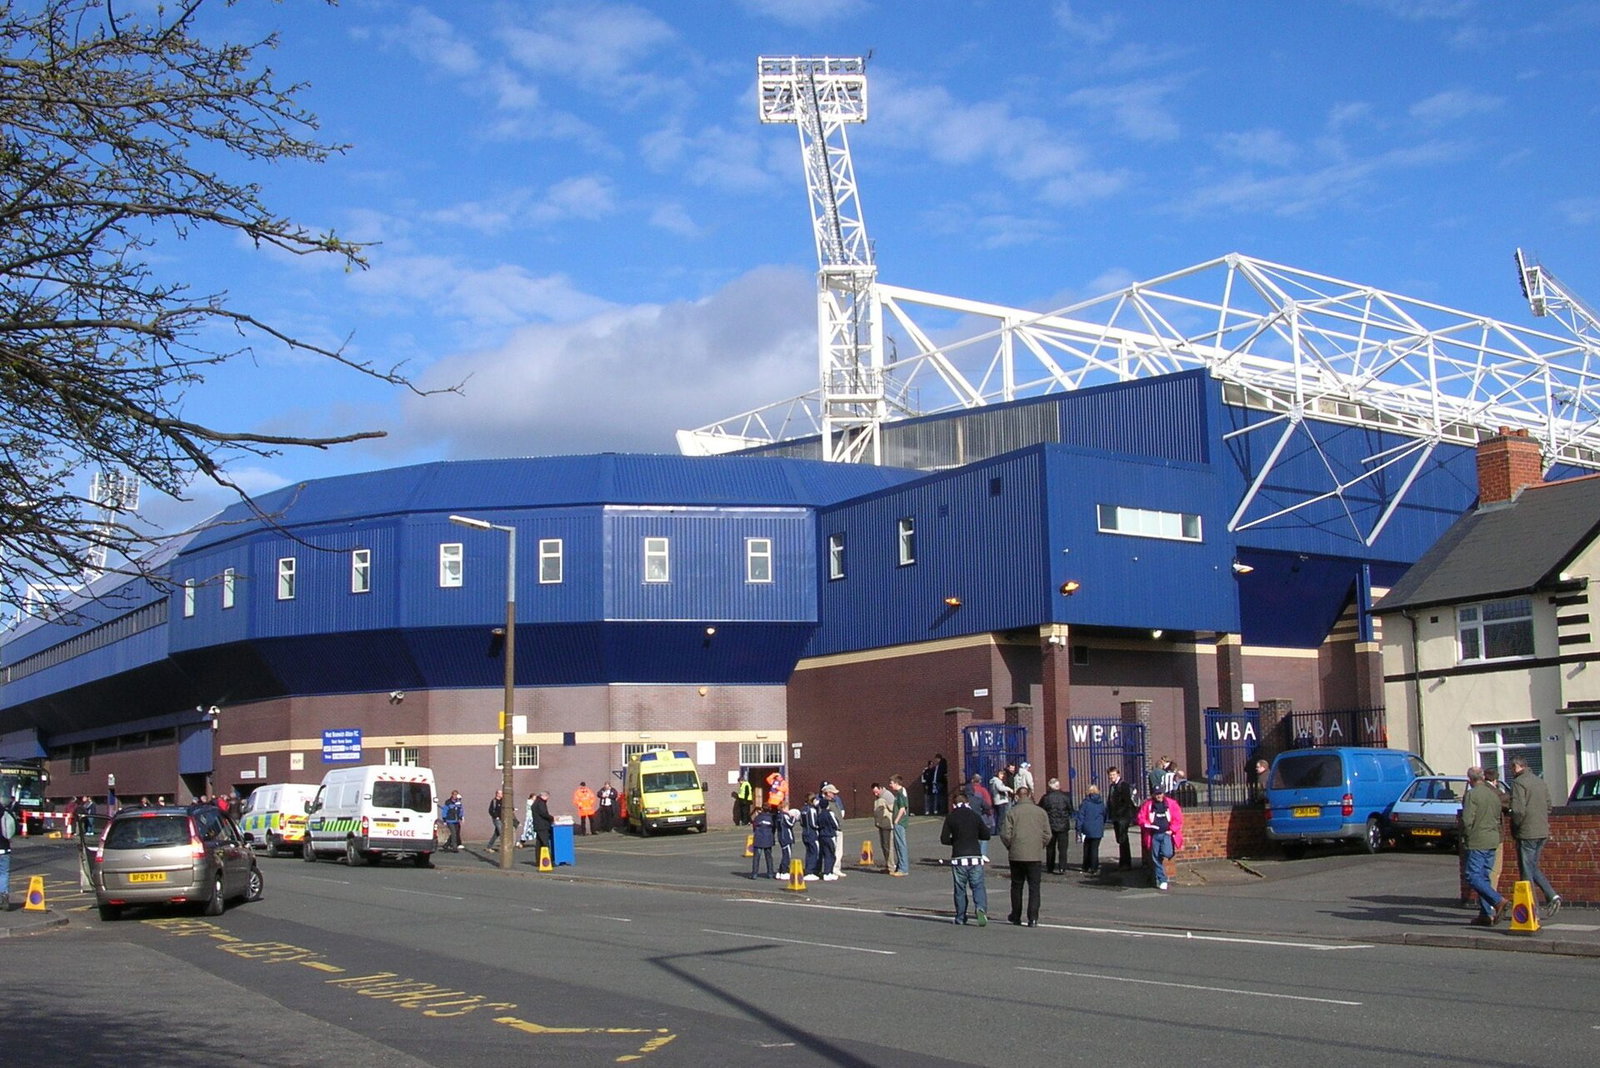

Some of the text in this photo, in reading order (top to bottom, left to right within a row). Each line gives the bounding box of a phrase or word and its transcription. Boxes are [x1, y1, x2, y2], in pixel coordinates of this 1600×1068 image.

[1071, 724, 1119, 743] WBA
[1216, 721, 1257, 741] WBA
[1297, 718, 1343, 739] WBA
[386, 829, 415, 837] POLICE
